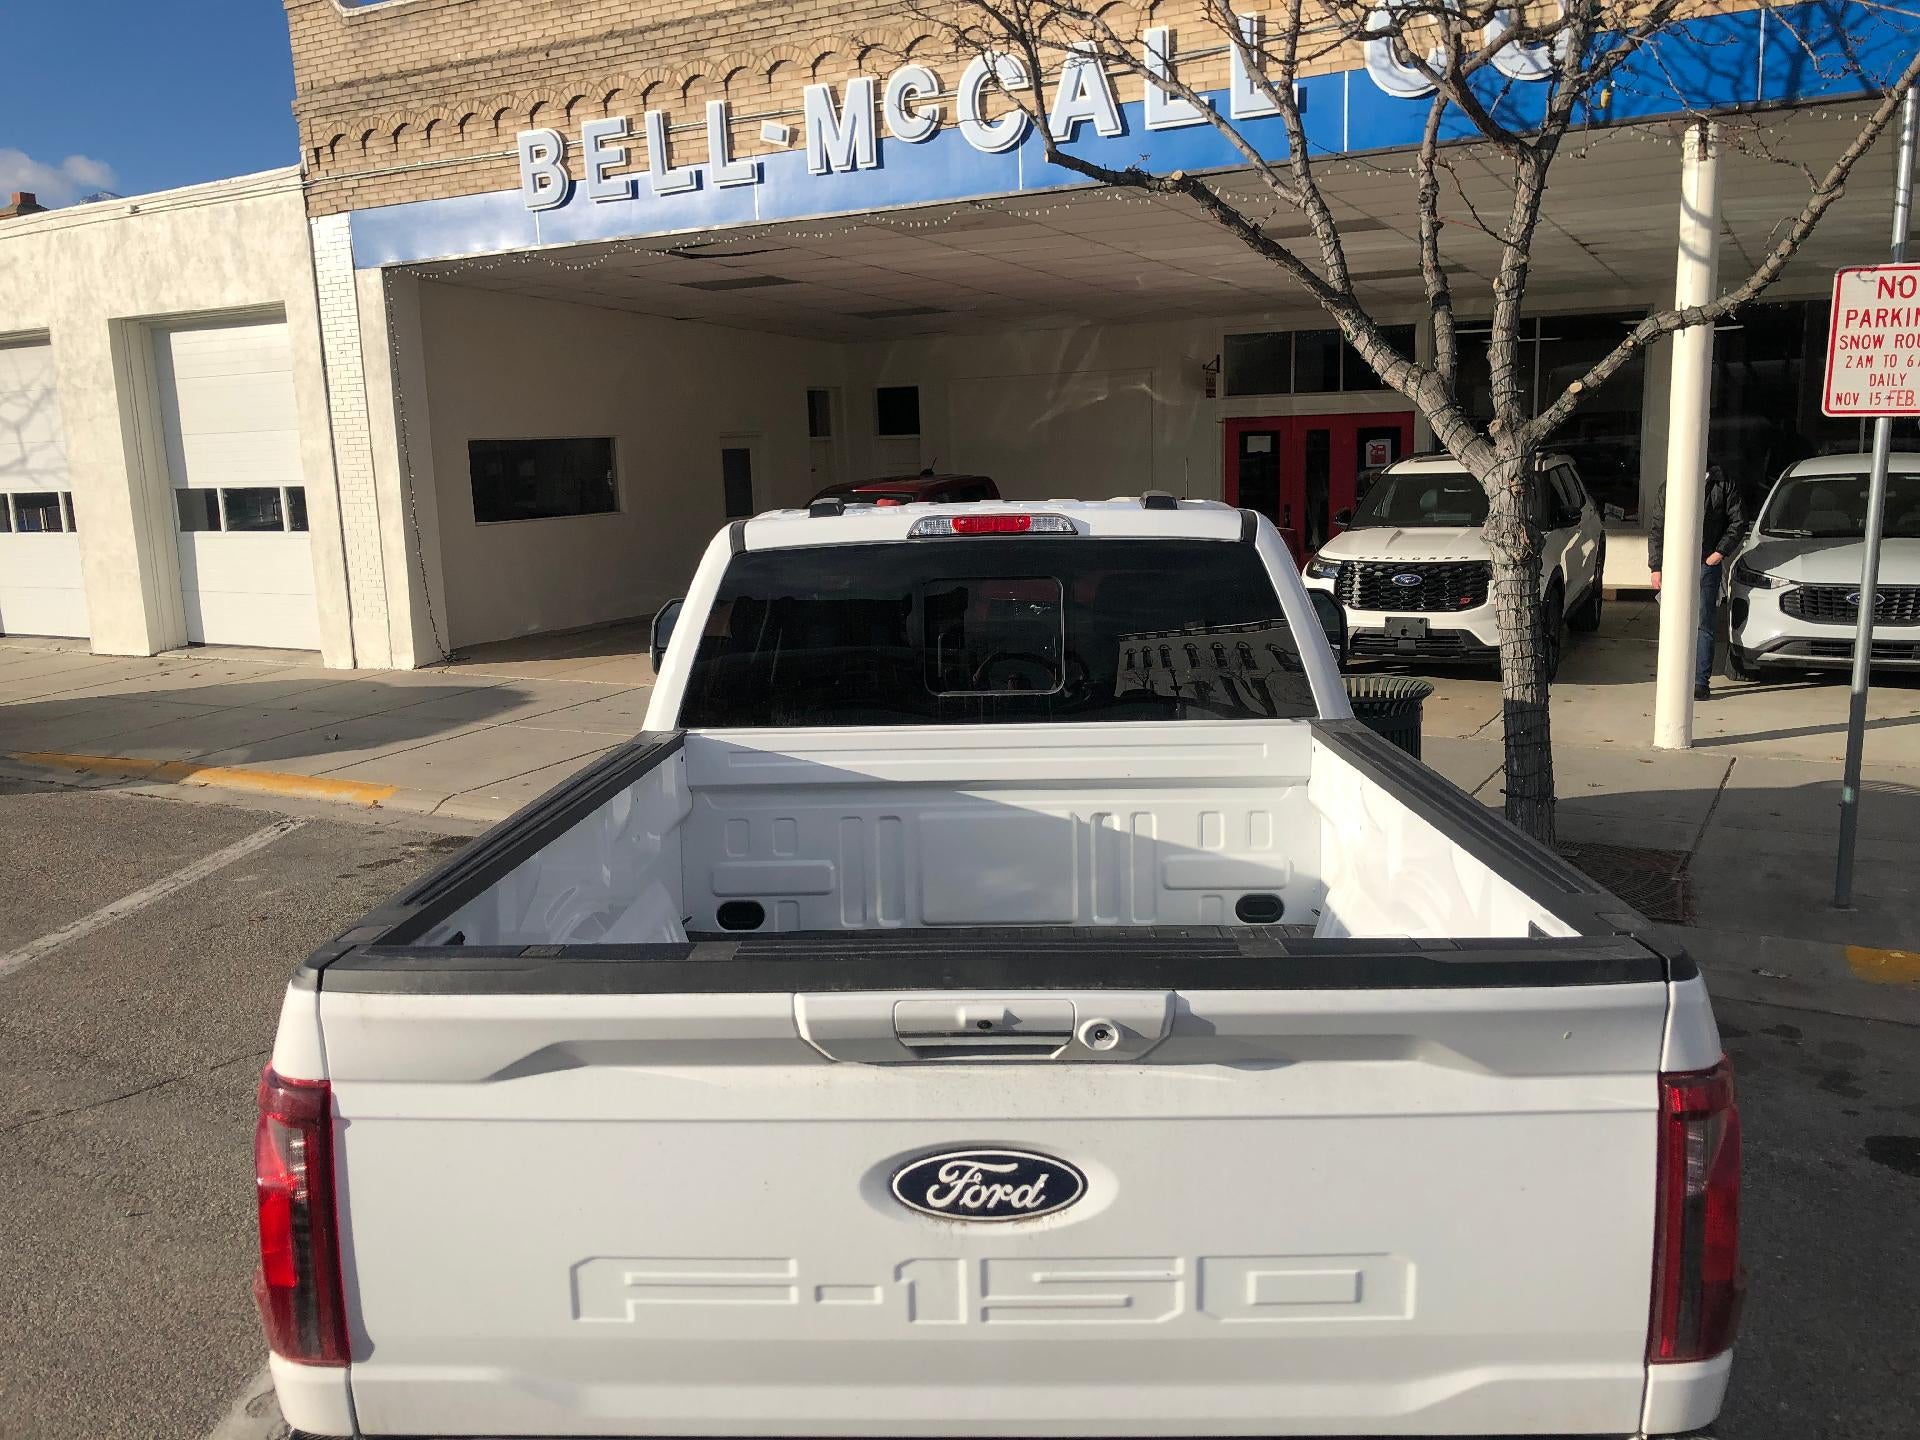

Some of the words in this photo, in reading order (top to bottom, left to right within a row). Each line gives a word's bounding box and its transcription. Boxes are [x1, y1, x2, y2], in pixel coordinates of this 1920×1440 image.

[1877, 274, 1917, 299] NO
[1839, 334, 1885, 350] SNOW
[1884, 354, 1897, 368] TO
[1869, 373, 1907, 387] DAILY
[1836, 392, 1860, 406] NOV
[927, 1160, 1050, 1209] Ford
[569, 1253, 1417, 1325] F-150
